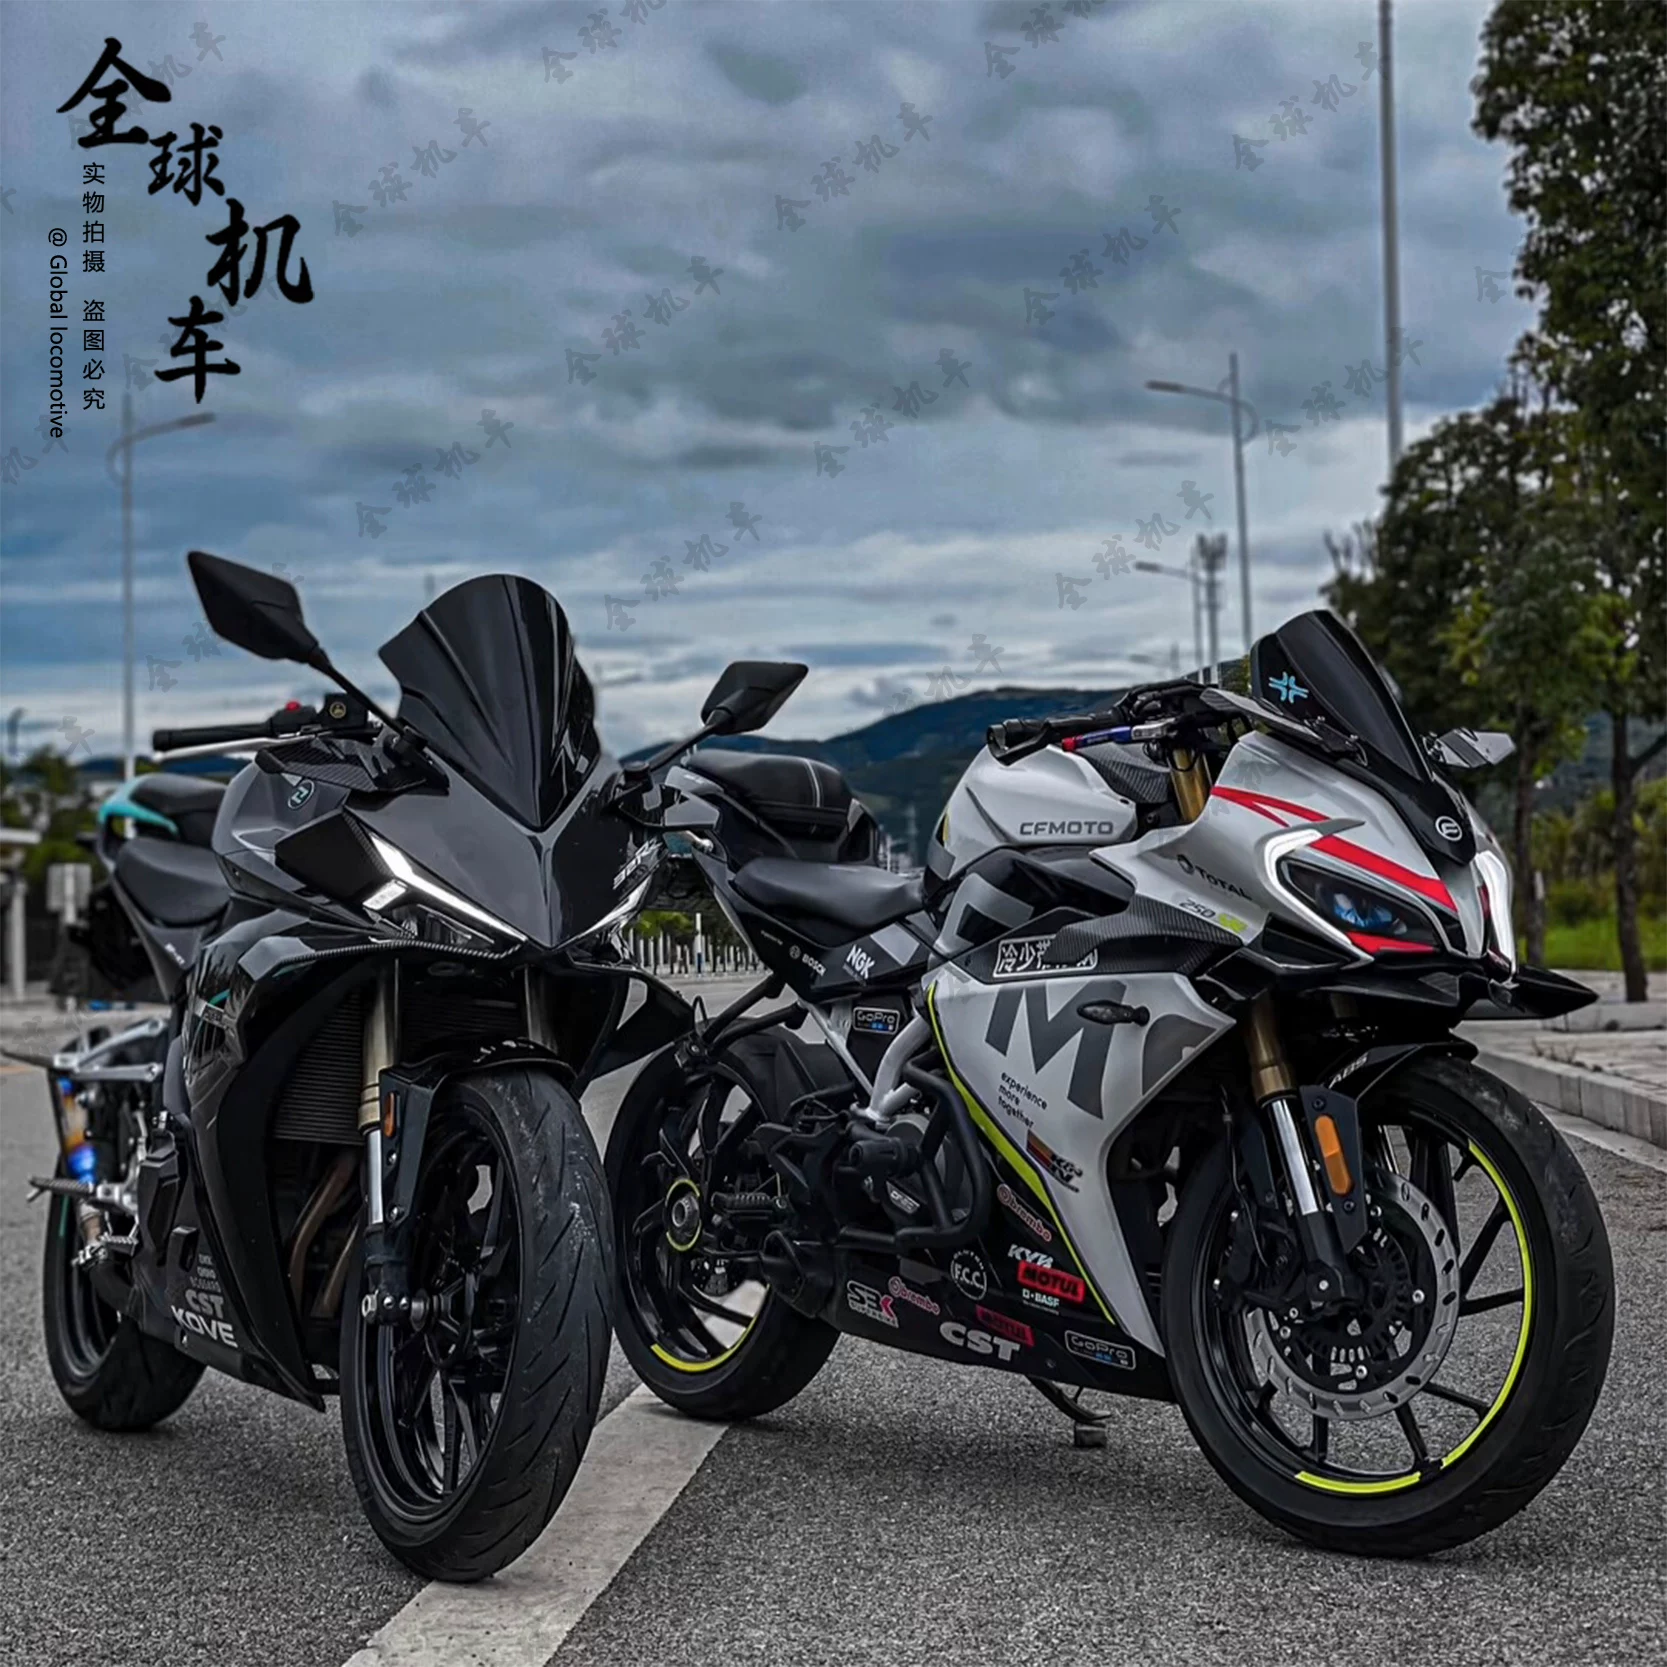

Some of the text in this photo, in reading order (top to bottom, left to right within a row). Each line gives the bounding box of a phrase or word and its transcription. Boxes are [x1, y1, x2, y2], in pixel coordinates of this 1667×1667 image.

[1020, 821, 1114, 836] CFMOTO
[1195, 865, 1252, 901] TOTAL
[1180, 897, 1216, 918] 250
[802, 953, 826, 976] BOSCH
[846, 944, 875, 979] NGK
[857, 1010, 896, 1024] GoPro
[998, 1084, 1020, 1106] more
[1001, 1072, 1047, 1110] experience
[998, 1095, 1034, 1128] together
[1004, 1191, 1052, 1242] brembo
[1022, 1264, 1081, 1300] MOTUL
[185, 1289, 224, 1319] CST
[171, 1304, 239, 1348] KOVE
[939, 1321, 1021, 1361] CST
[1070, 1335, 1129, 1360] GoPro
